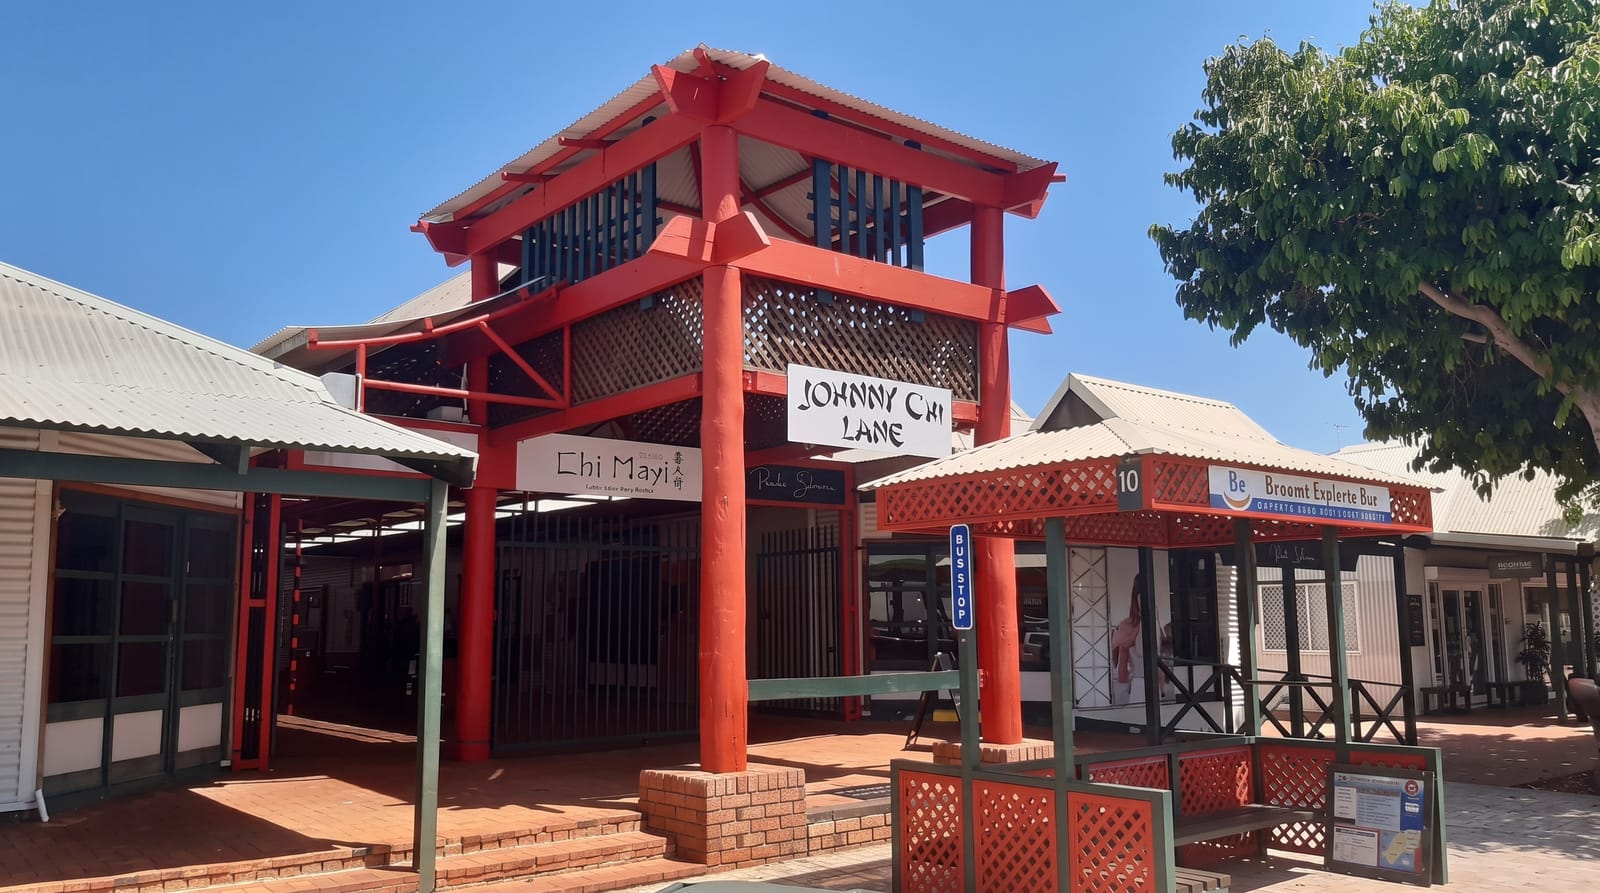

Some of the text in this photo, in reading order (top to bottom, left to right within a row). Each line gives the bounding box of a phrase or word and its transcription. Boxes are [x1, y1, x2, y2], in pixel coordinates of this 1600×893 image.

[797, 379, 898, 413] JOHNNY
[842, 415, 904, 448] LANE
[557, 451, 669, 486] Chi Mayi
[1119, 470, 1139, 492] 10
[1229, 470, 1246, 493] Be
[955, 534, 966, 620] BUS STOP
